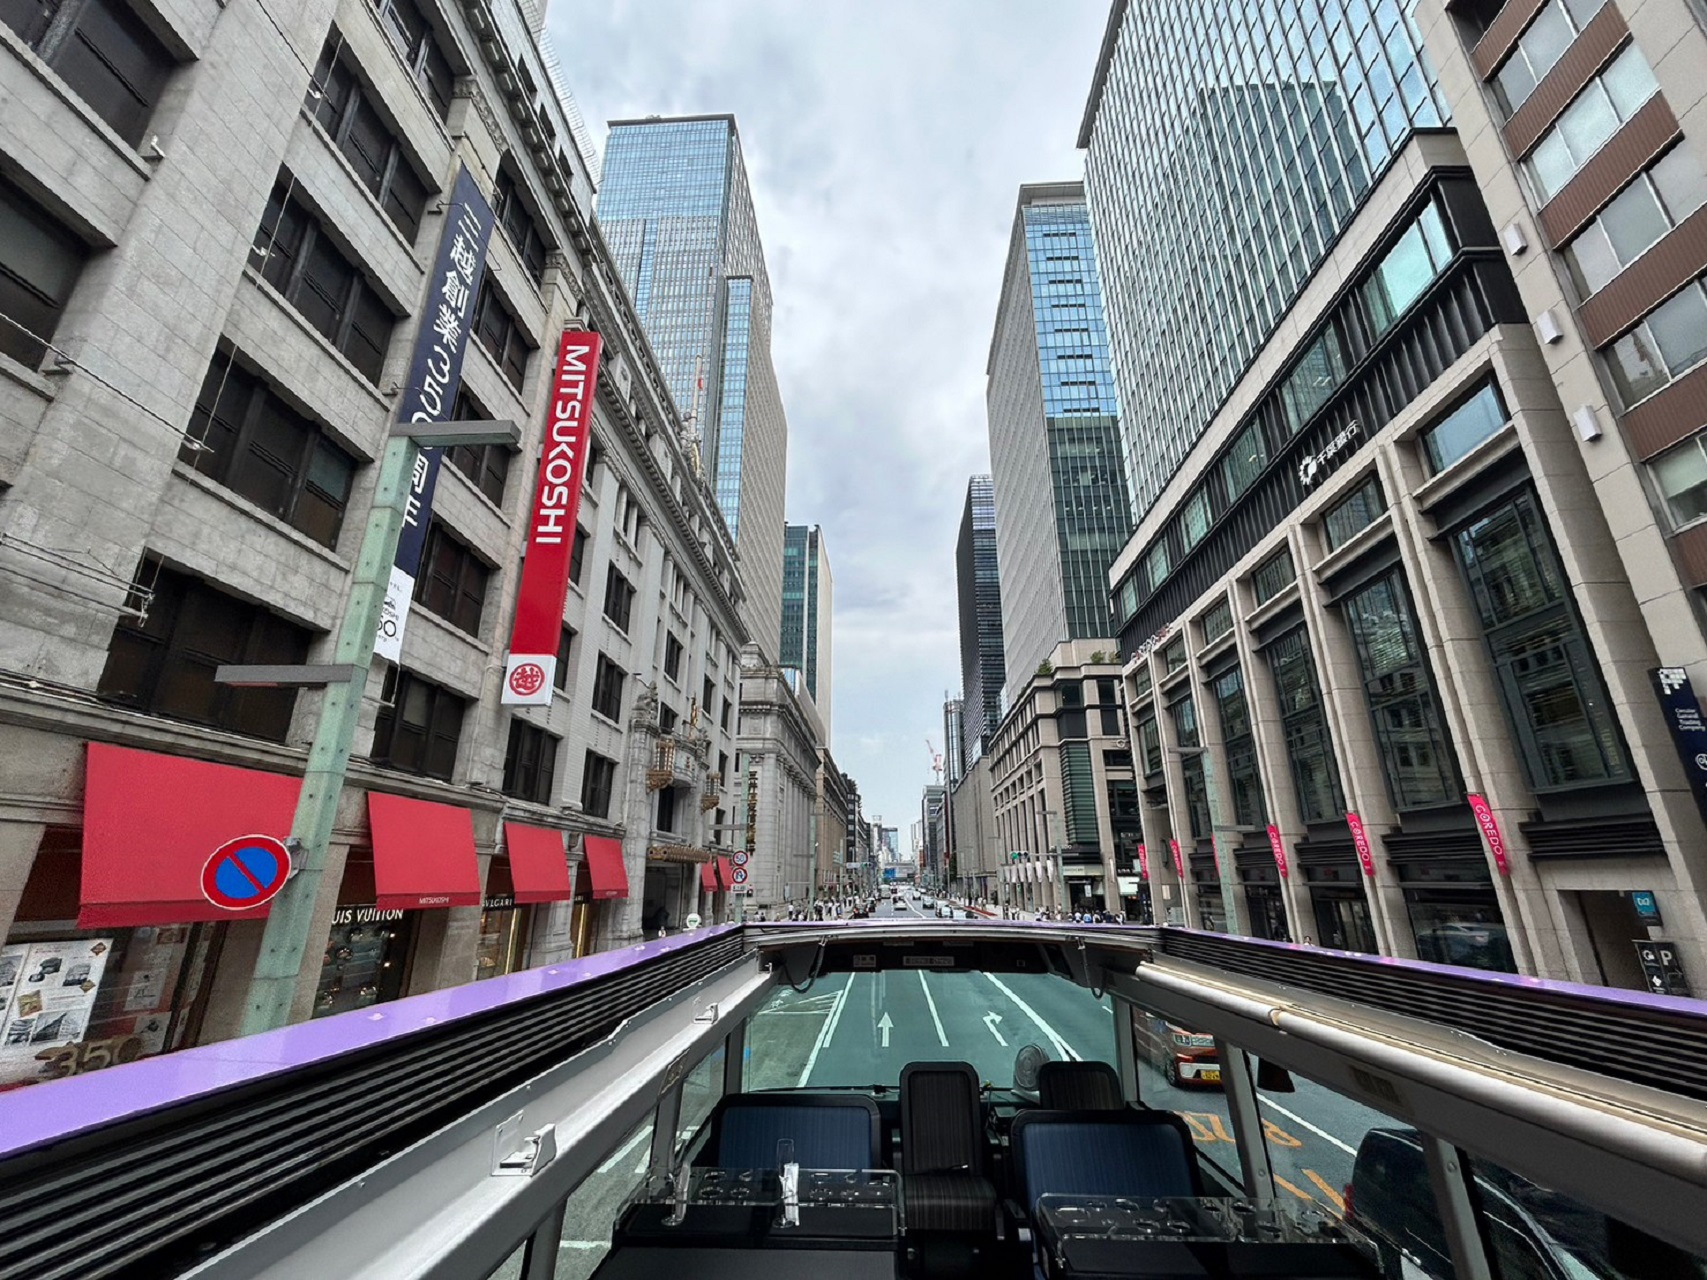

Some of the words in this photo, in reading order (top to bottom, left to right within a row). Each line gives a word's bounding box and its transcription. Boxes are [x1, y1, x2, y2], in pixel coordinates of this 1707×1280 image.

[536, 345, 590, 544] MITSUKOSHI
[1349, 820, 1370, 863] COREDO
[1475, 804, 1503, 856] COREDO
[332, 909, 353, 924] UIS
[1660, 950, 1672, 966] P
